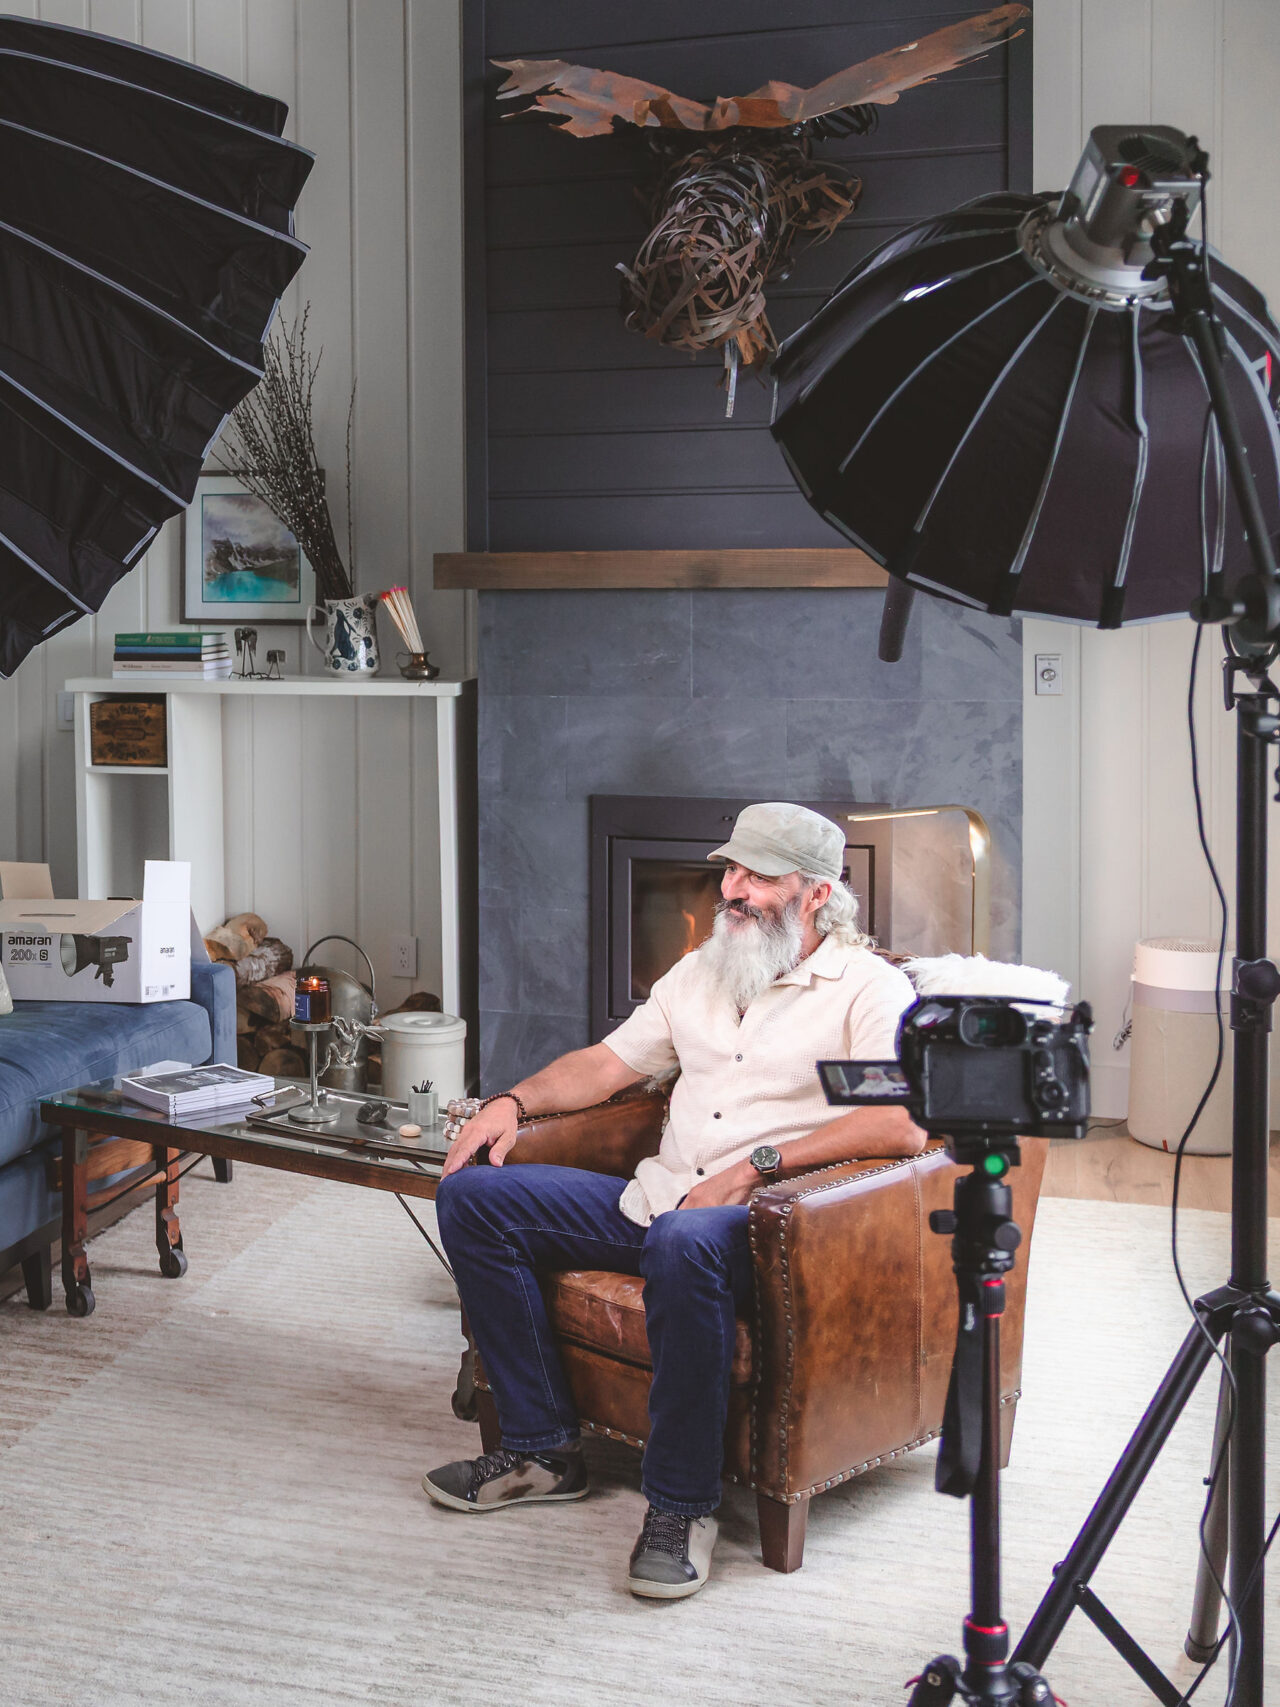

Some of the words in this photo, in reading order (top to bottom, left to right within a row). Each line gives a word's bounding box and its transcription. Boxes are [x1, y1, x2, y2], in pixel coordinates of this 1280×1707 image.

[7, 935, 52, 945] amaran
[10, 948, 37, 961] 200x
[39, 949, 49, 961] S
